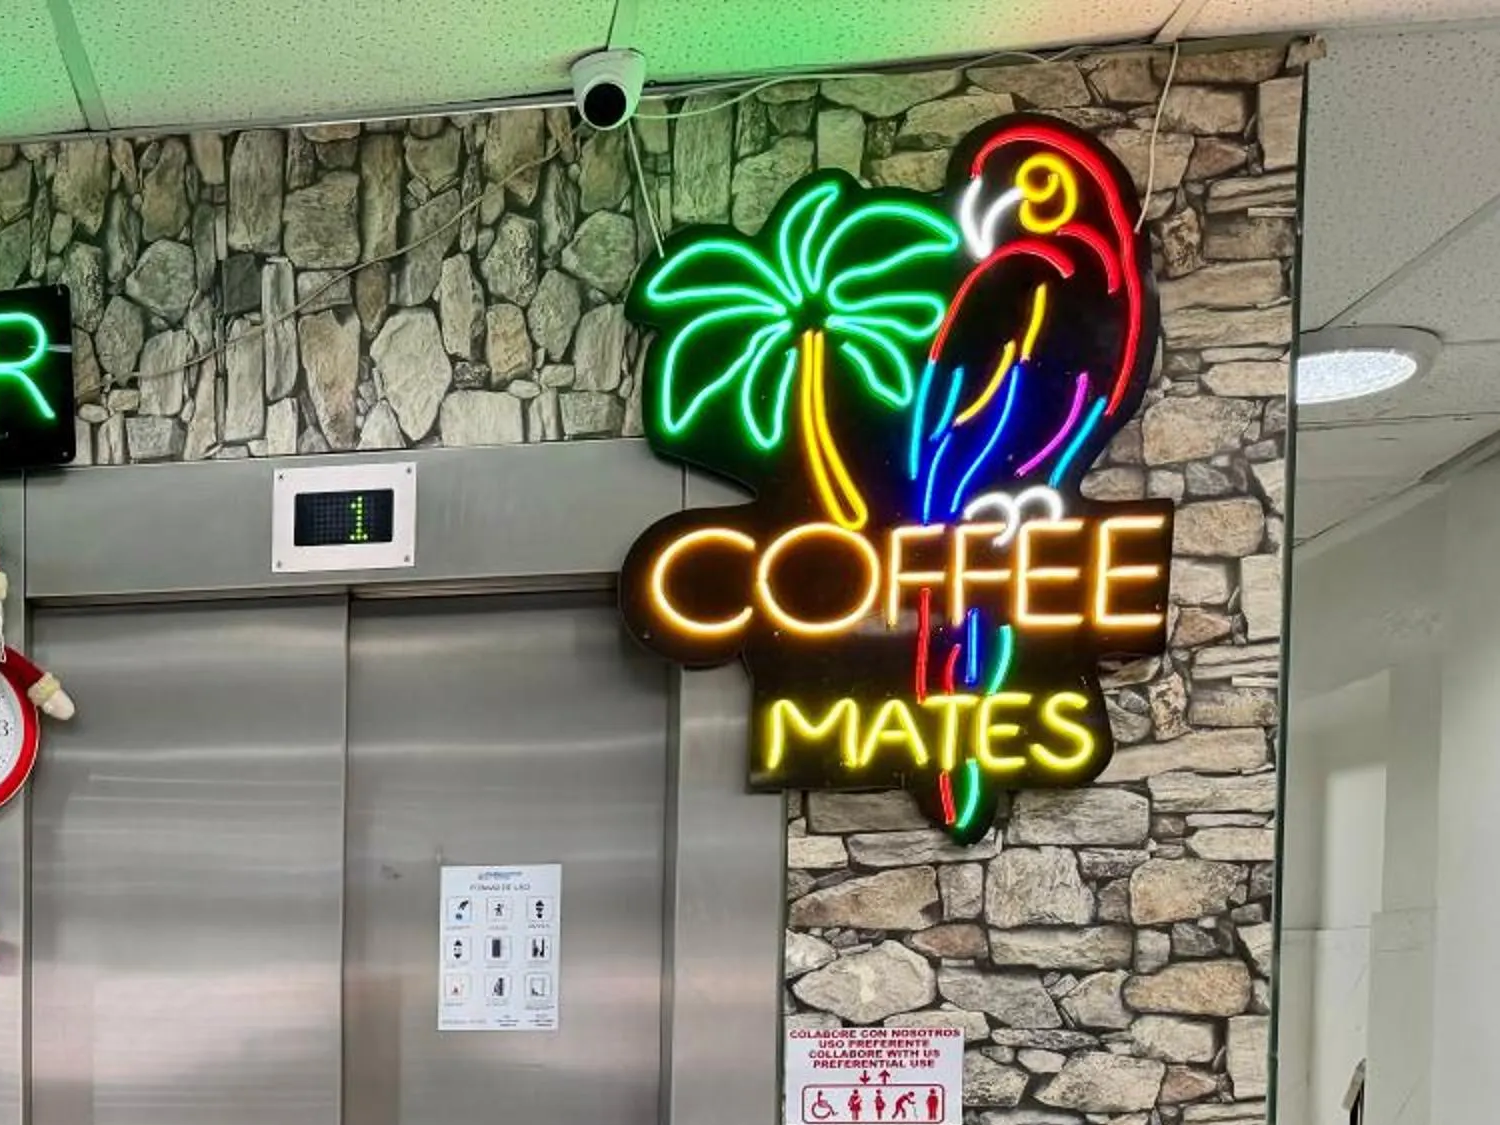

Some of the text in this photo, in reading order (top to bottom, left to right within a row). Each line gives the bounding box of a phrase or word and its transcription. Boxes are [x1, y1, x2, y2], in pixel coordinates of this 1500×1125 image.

[349, 495, 368, 541] 1
[651, 514, 1166, 633] COFFEE
[764, 692, 1095, 771] MATES
[789, 1029, 961, 1039] COLABORE CON NOSOTROS
[818, 1039, 930, 1049] USO PREFERENTE
[808, 1049, 941, 1058] COLLABORE WITH US
[813, 1059, 935, 1068] PREFERENTIAL USE
